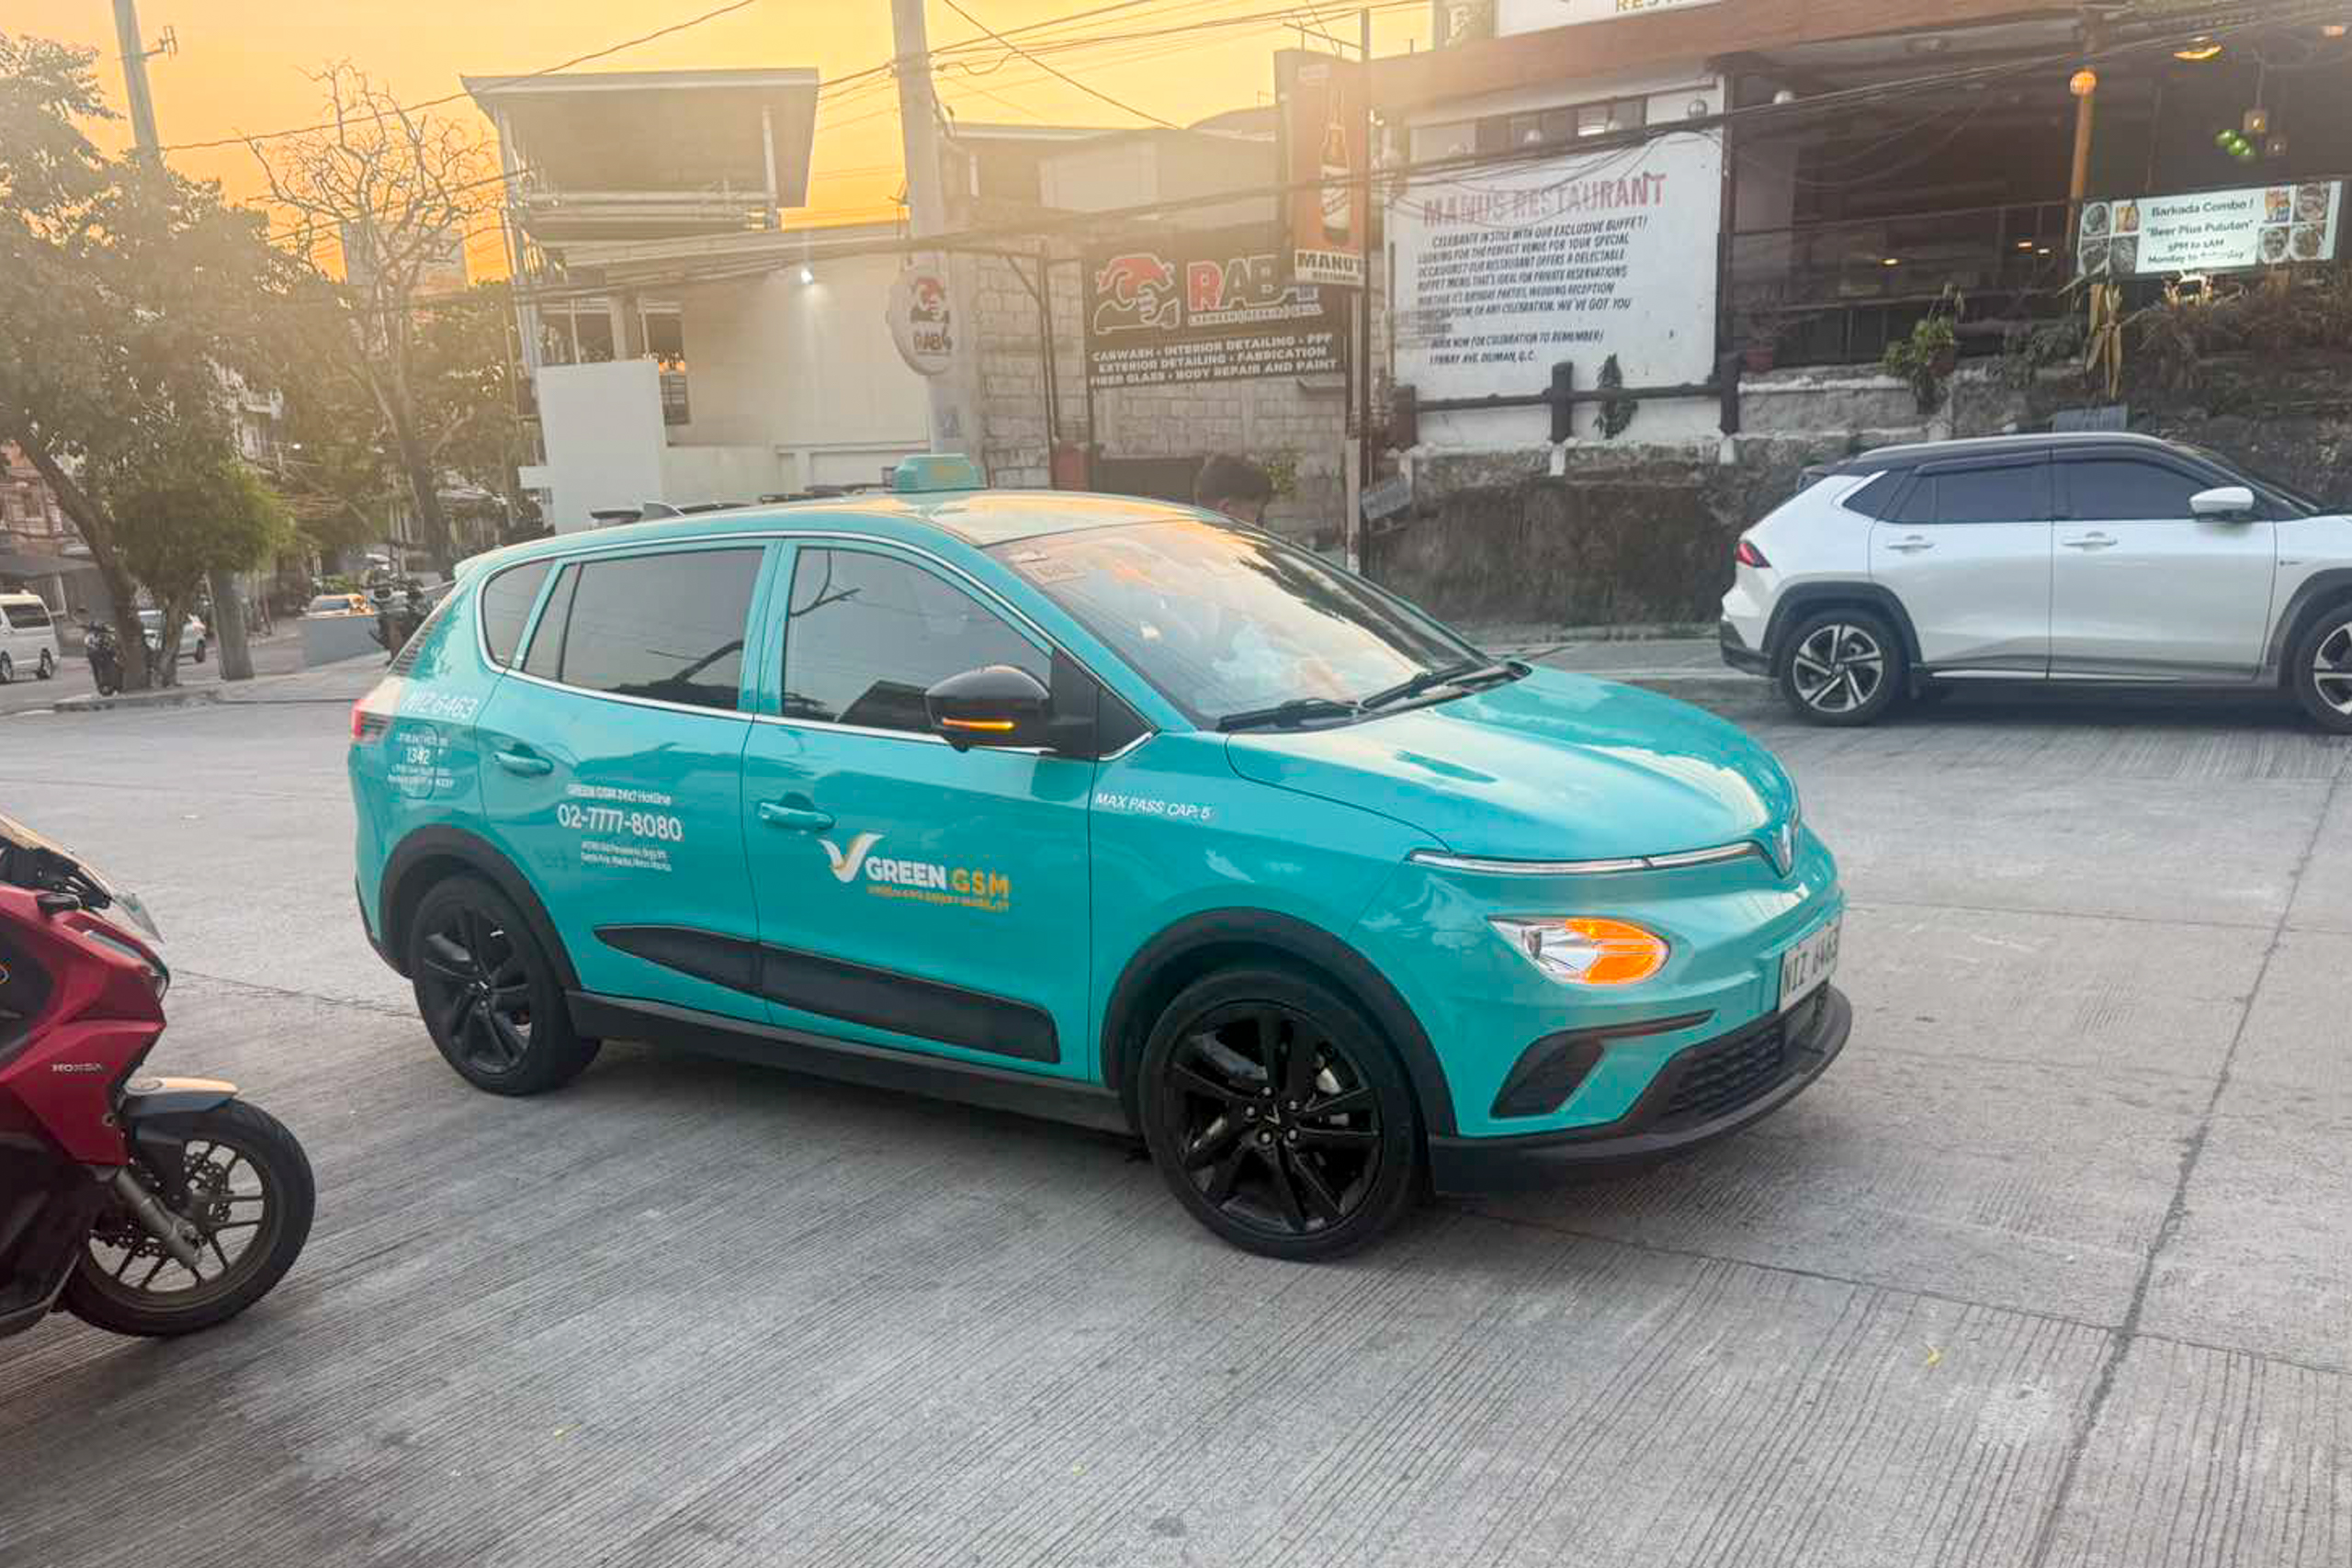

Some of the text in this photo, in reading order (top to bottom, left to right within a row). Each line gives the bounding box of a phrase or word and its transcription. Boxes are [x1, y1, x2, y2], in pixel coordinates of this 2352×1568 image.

[1513, 173, 1668, 219] RESTAURANT
[2152, 205, 2200, 217] Barkada
[2203, 201, 2246, 212] Combo
[1554, 220, 1604, 236] EXCLUSIVE
[1549, 240, 1566, 253] FOR
[1568, 237, 1591, 250] YOUR
[1593, 232, 1629, 247] SPECIAL
[1575, 248, 1624, 264] DELECTABLE
[1534, 269, 1565, 282] PRIVATE
[1566, 265, 1628, 281] RESERVATIONS
[1567, 281, 1616, 296] RECEPTION
[1589, 299, 1610, 310] GOT
[1611, 297, 1632, 310] YOU
[1225, 333, 1295, 353] DETAILING
[1160, 352, 1227, 369] DETAILING
[1237, 345, 1328, 365] FABRICATION
[1264, 361, 1293, 375] AND
[1295, 358, 1337, 373] PAINT
[1095, 792, 1127, 809] MAX
[1128, 796, 1165, 816] PASS
[1201, 807, 1213, 818] 5
[557, 803, 683, 842] 02-7777-8080
[865, 855, 947, 890] GREEN
[952, 866, 1012, 899] GSM
